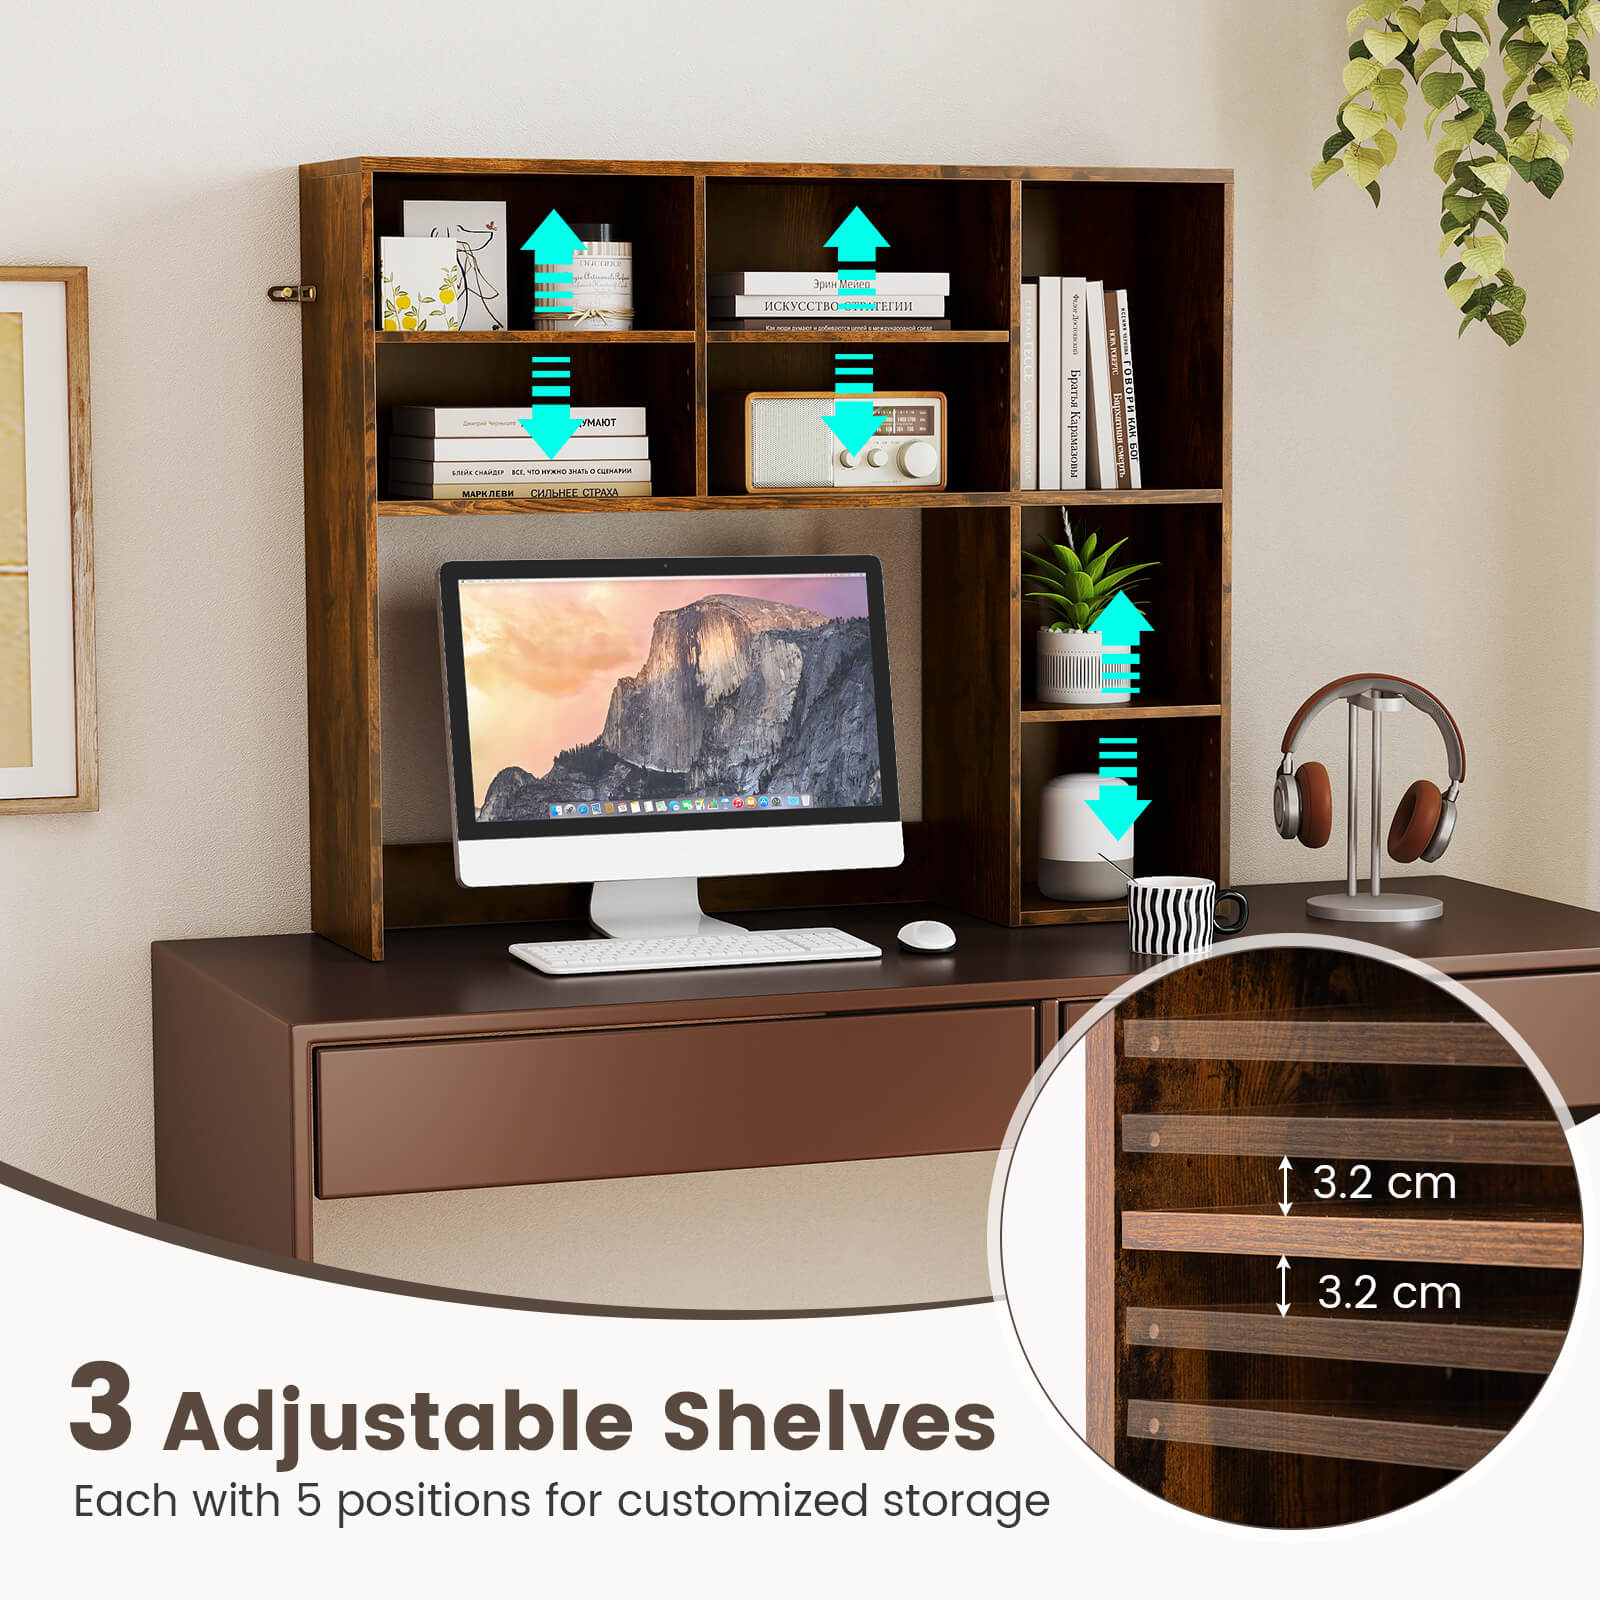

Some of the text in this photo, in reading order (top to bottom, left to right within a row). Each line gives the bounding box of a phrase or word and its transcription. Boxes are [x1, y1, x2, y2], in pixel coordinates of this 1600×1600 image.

[813, 279, 837, 291] Эрин
[764, 301, 839, 312] ИСКУССТВО
[1123, 360, 1139, 461] ГОВОРИ КАК БОГ
[579, 418, 617, 428] УМАЮТ
[1067, 369, 1081, 478] Братья Карамазовы
[1112, 393, 1126, 478] Бархатная смерть
[452, 468, 505, 477] БЛЕЙК СНАЙДЕР
[462, 490, 514, 498] МАРК ЛЕВИ
[530, 488, 619, 498] СИЛЬНЕЕ СТРАХА
